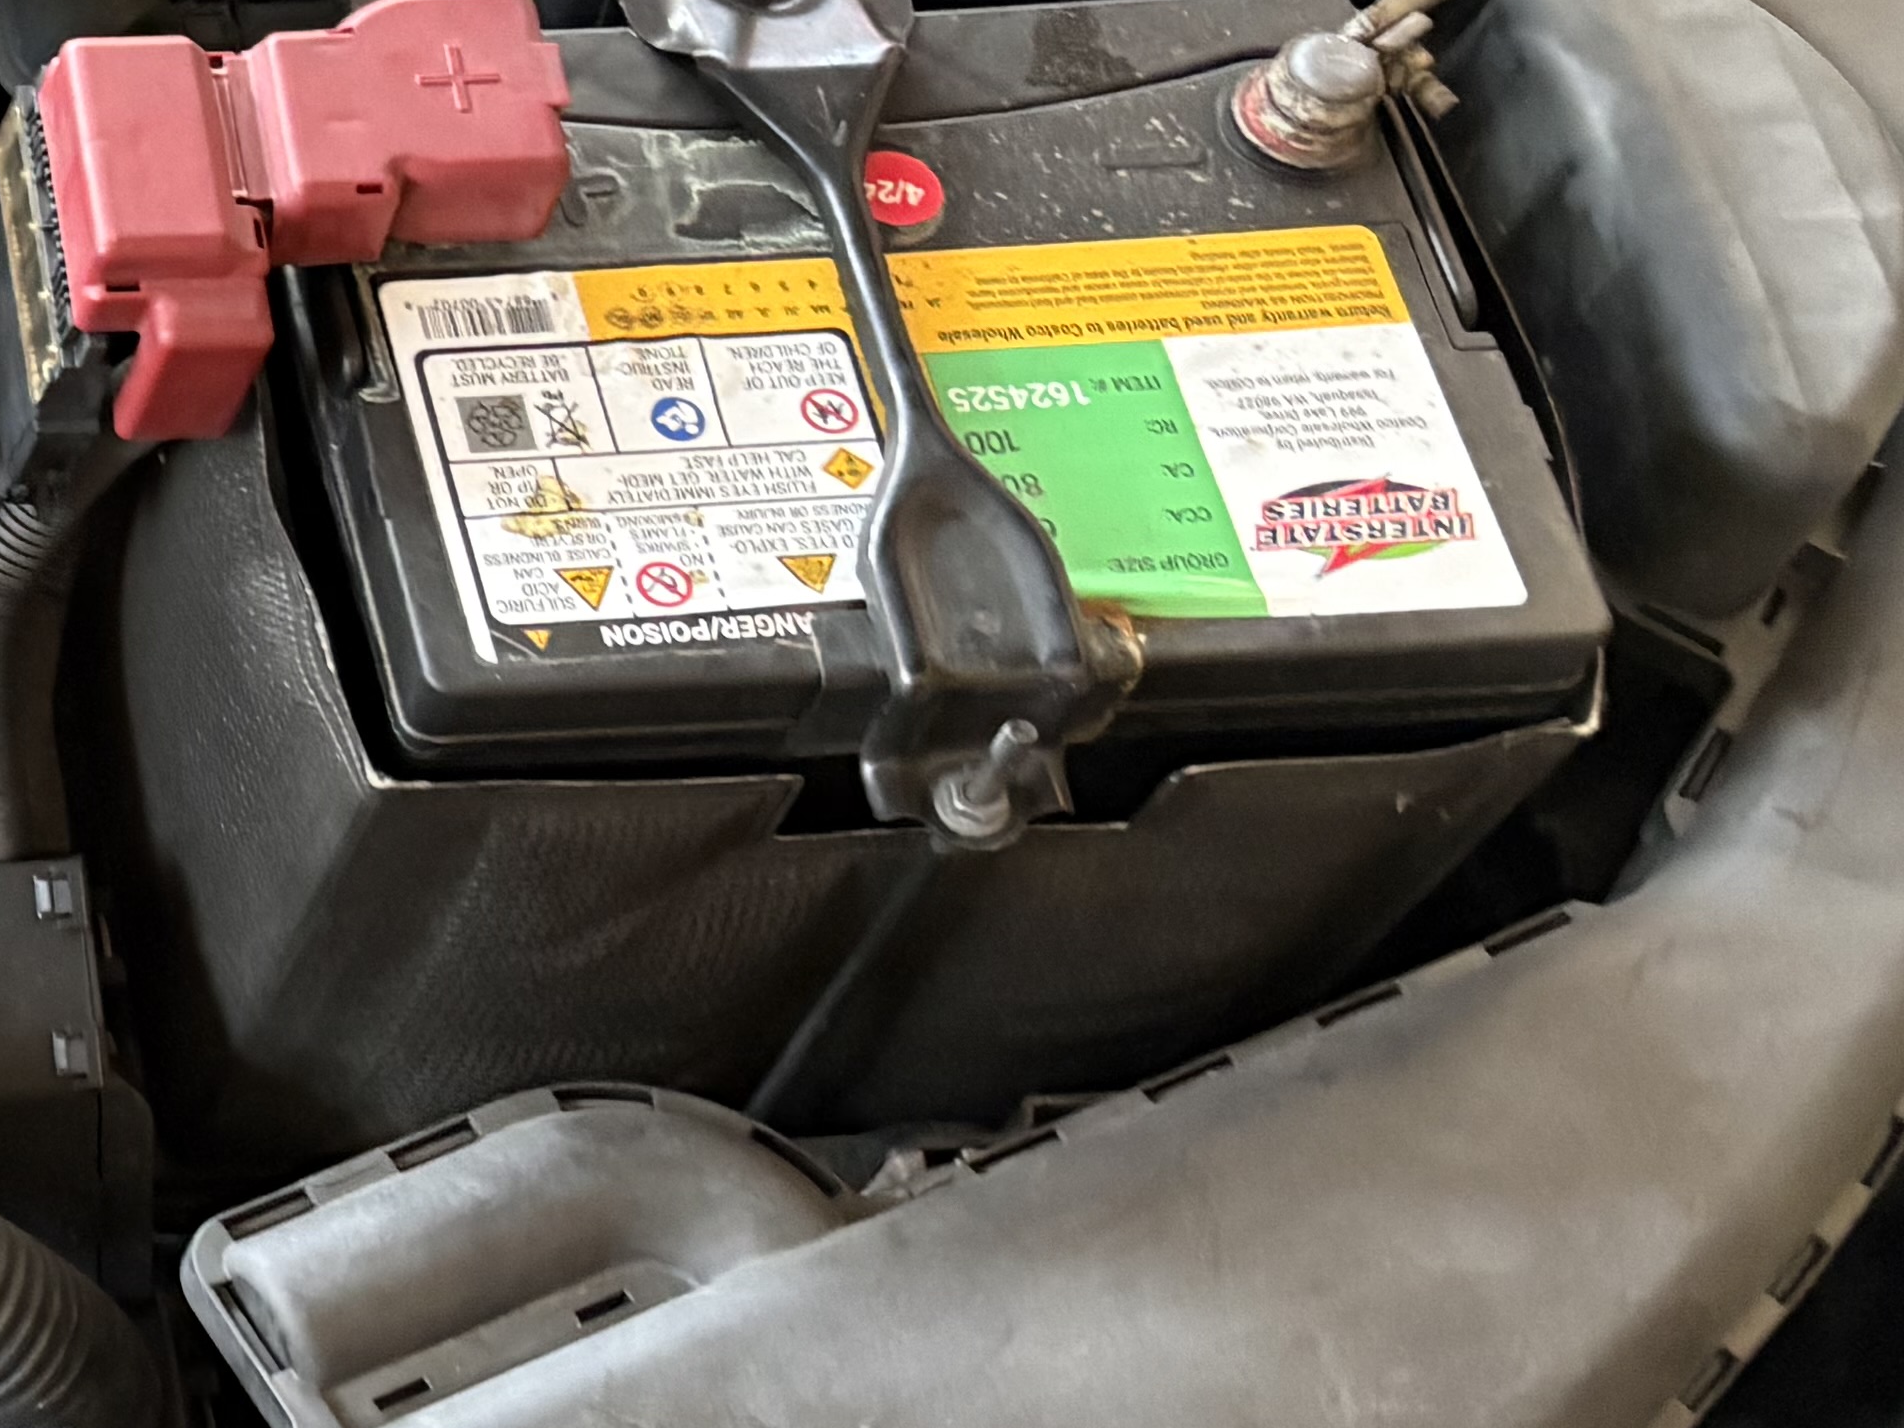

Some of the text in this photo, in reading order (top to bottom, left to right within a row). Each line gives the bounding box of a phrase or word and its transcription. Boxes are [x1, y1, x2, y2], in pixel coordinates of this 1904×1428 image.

[1181, 316, 1222, 331] used
[1226, 314, 1256, 329] and
[1262, 309, 1333, 324] warranty
[1026, 323, 1083, 337] Costco
[1086, 323, 1104, 335] to
[1106, 318, 1182, 334] batteries
[937, 327, 1024, 345] Wholesale
[814, 342, 837, 355] OF
[749, 357, 842, 374] THE REACH
[450, 368, 570, 387] BATTERY MUST
[652, 376, 693, 391] READ
[744, 372, 847, 390] KEEP OUT OF
[1110, 375, 1161, 390] ITEM
[947, 381, 1090, 412] 1624525
[964, 430, 1020, 456] 100
[1276, 435, 1375, 453] Distributed by
[727, 451, 765, 466] HELP
[773, 449, 806, 462] CAL
[670, 472, 701, 485] GET
[766, 465, 811, 479] WITH
[488, 482, 514, 495] OR
[607, 480, 816, 505] FLUSH EYES IMMEDIATELY
[487, 497, 521, 511] NOT
[1262, 489, 1456, 523] BATTERIES
[714, 524, 763, 538] CAUSE
[767, 522, 796, 535] CAN
[1255, 513, 1474, 550] INTERSTATE
[482, 548, 611, 566] CAUSE BLINDNESS
[680, 553, 705, 566] NO
[1160, 552, 1229, 571] GROUP
[513, 567, 544, 580] CAN
[521, 582, 559, 595] ACID
[495, 597, 577, 613] SULFURIC
[599, 611, 814, 647] ANGER/POISON
